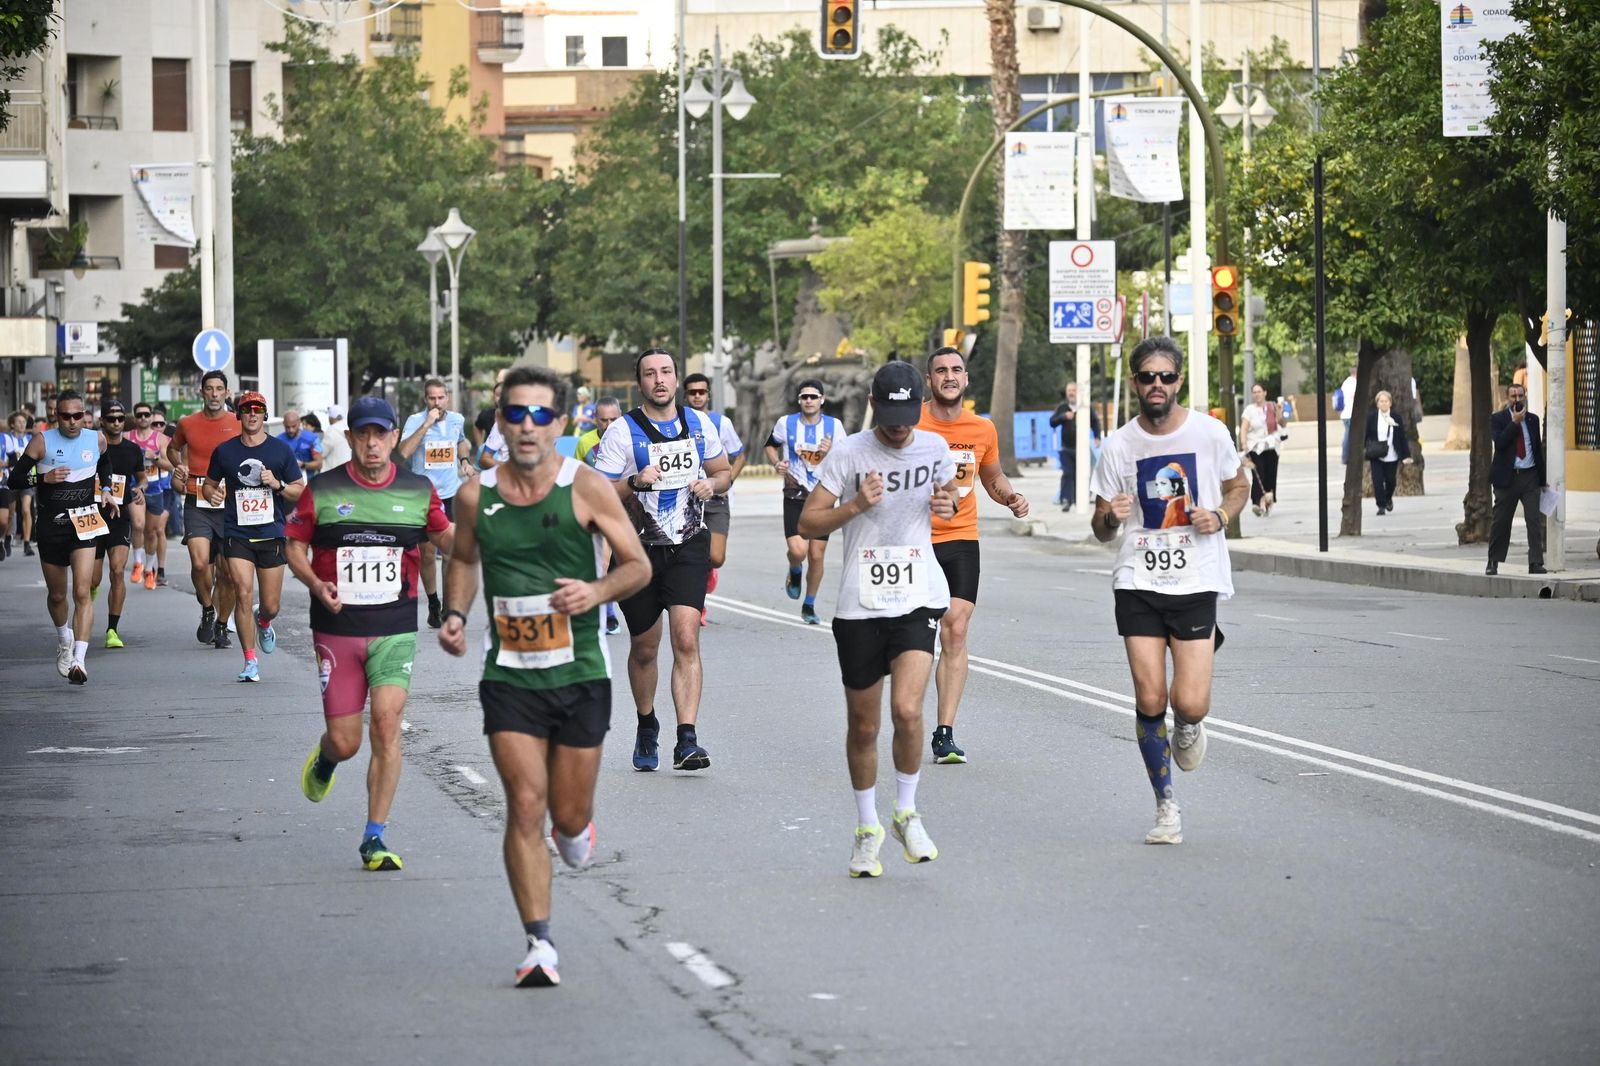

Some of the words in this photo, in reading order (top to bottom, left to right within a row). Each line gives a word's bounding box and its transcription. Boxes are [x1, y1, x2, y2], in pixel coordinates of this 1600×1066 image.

[430, 448, 451, 458] 445
[659, 452, 693, 472] 645
[855, 460, 942, 492] ISIDE
[242, 498, 268, 513] 624
[77, 514, 98, 528] 578
[341, 549, 354, 558] 2K
[386, 548, 398, 557] 2K
[863, 549, 876, 559] 2K
[909, 548, 921, 558] 2K
[1144, 549, 1187, 571] 993
[343, 562, 396, 583] 1113
[870, 562, 913, 585] 991
[507, 614, 554, 643] 531
